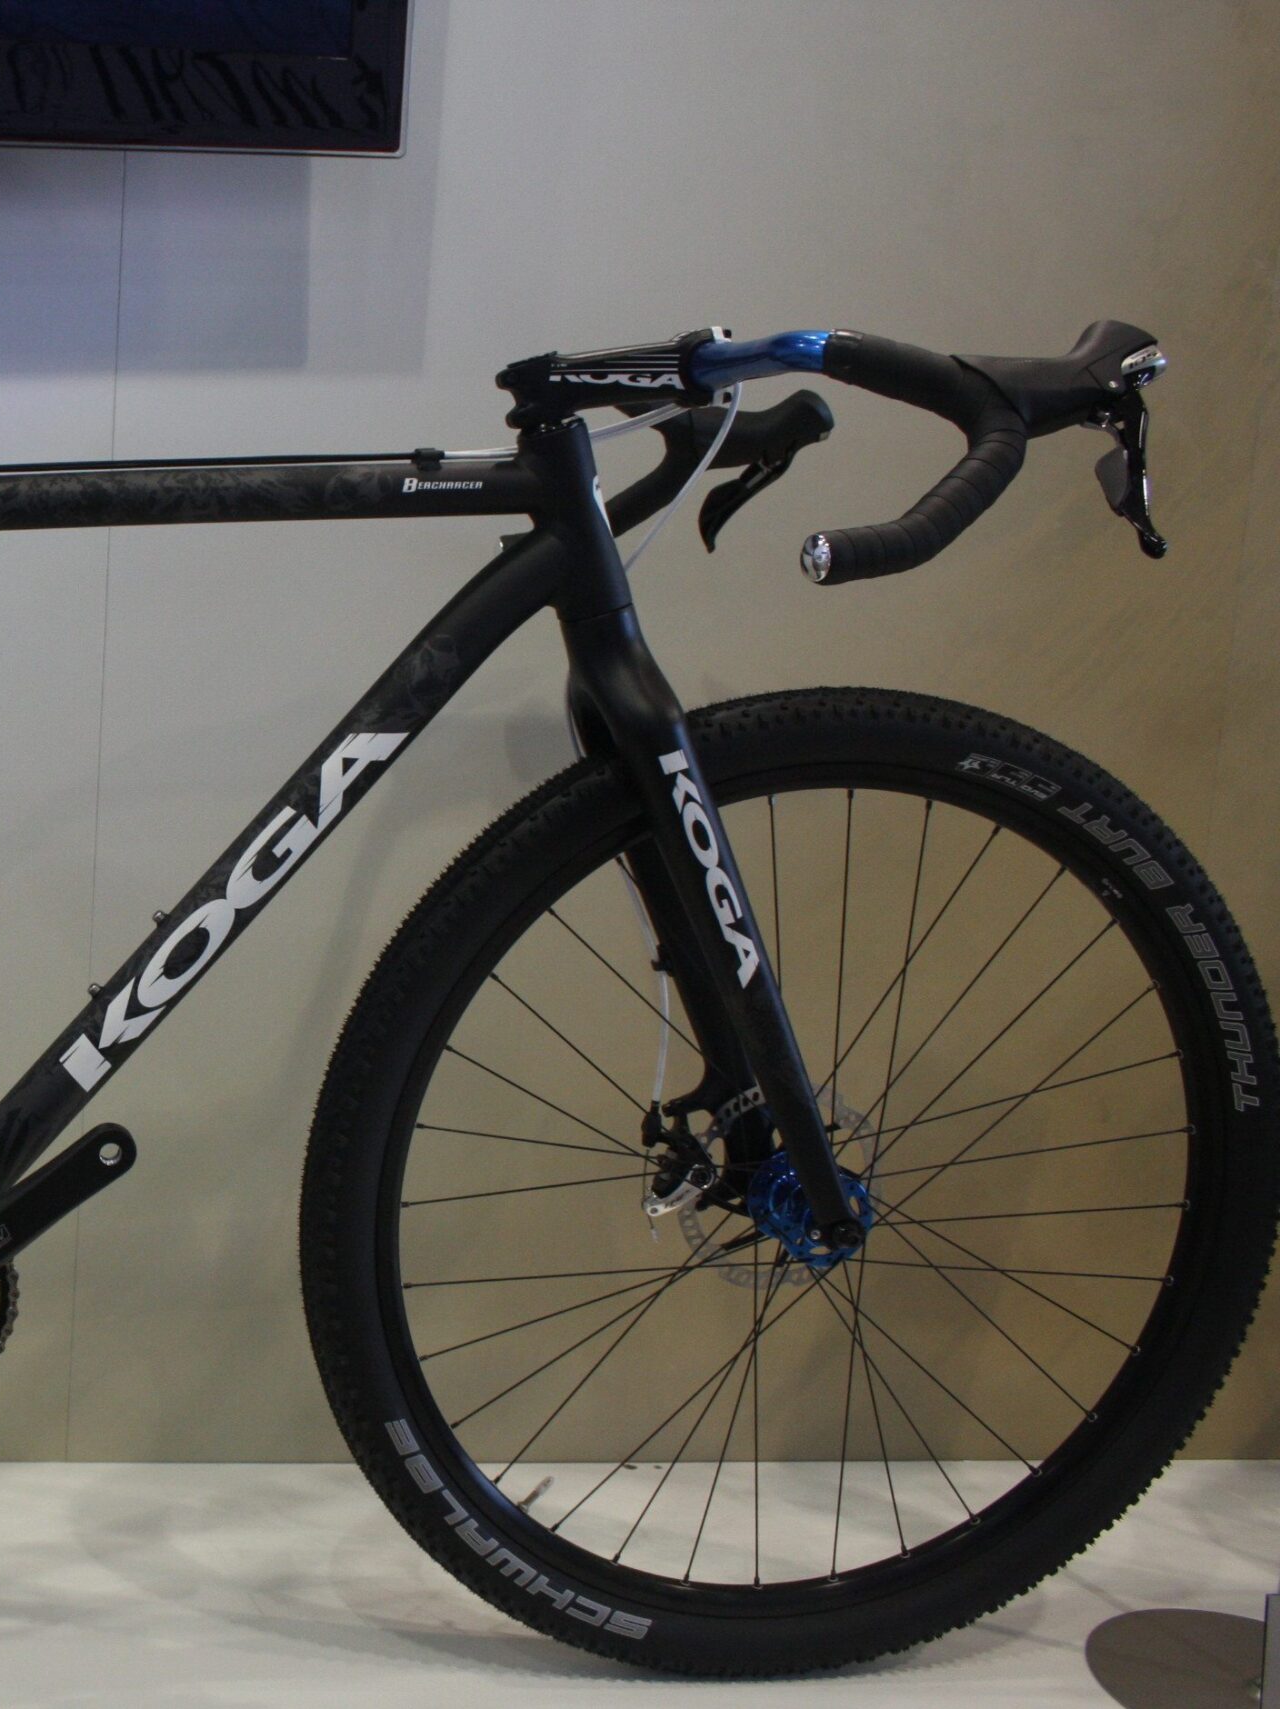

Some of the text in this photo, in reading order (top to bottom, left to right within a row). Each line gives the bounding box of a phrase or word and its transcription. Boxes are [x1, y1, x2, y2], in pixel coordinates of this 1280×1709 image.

[58, 732, 410, 1093] KOGA
[658, 749, 760, 990] KOGA
[1057, 802, 1174, 890] BURT
[1166, 903, 1260, 1112] THUNDER
[384, 1417, 653, 1640] SCHWALBE
